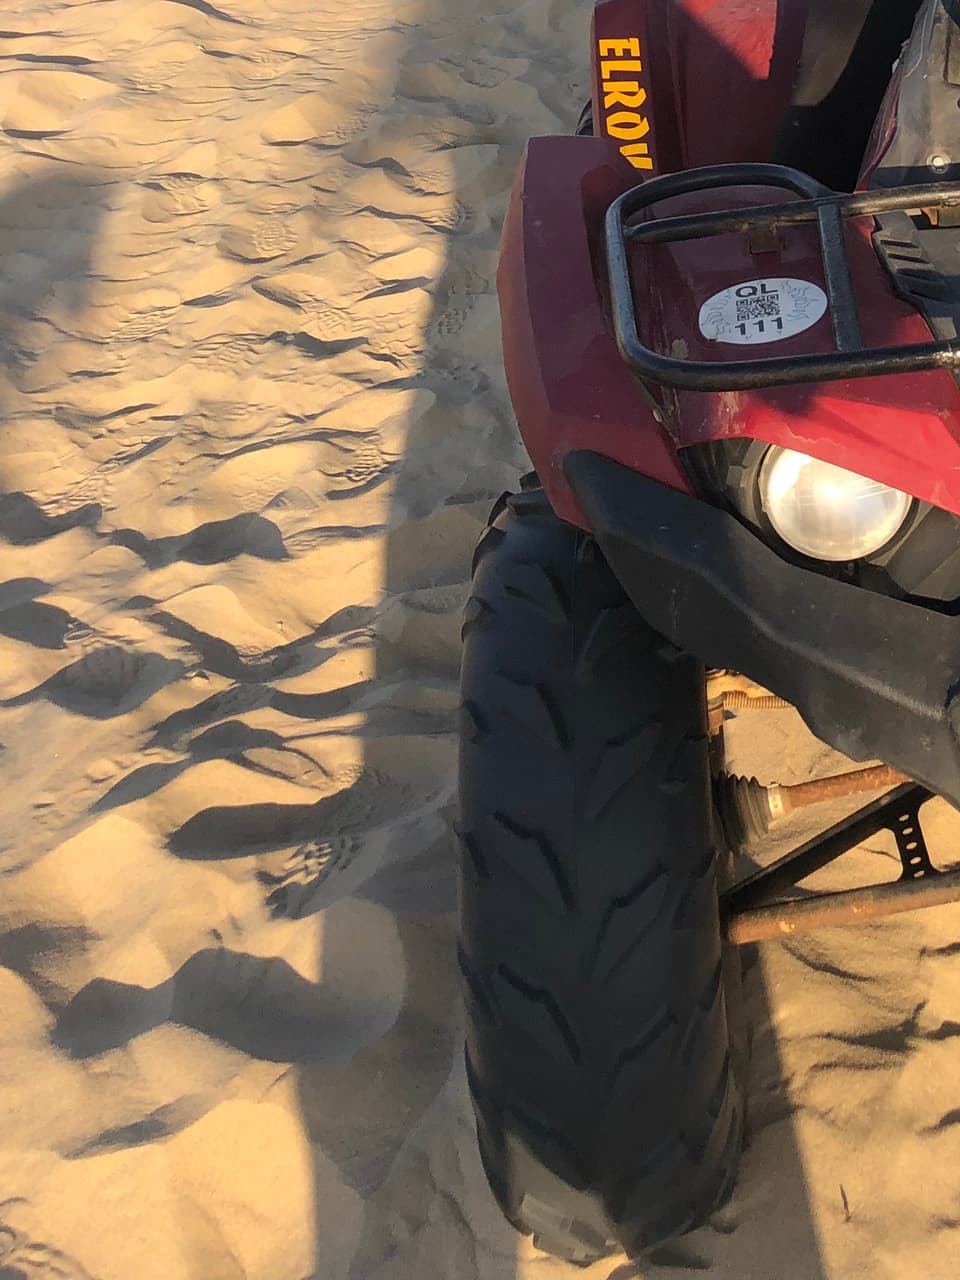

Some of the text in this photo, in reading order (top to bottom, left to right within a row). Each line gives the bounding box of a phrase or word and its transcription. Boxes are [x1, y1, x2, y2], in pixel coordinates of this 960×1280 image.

[599, 37, 653, 170] ELROY
[735, 283, 778, 297] QL
[735, 317, 783, 335] 111
